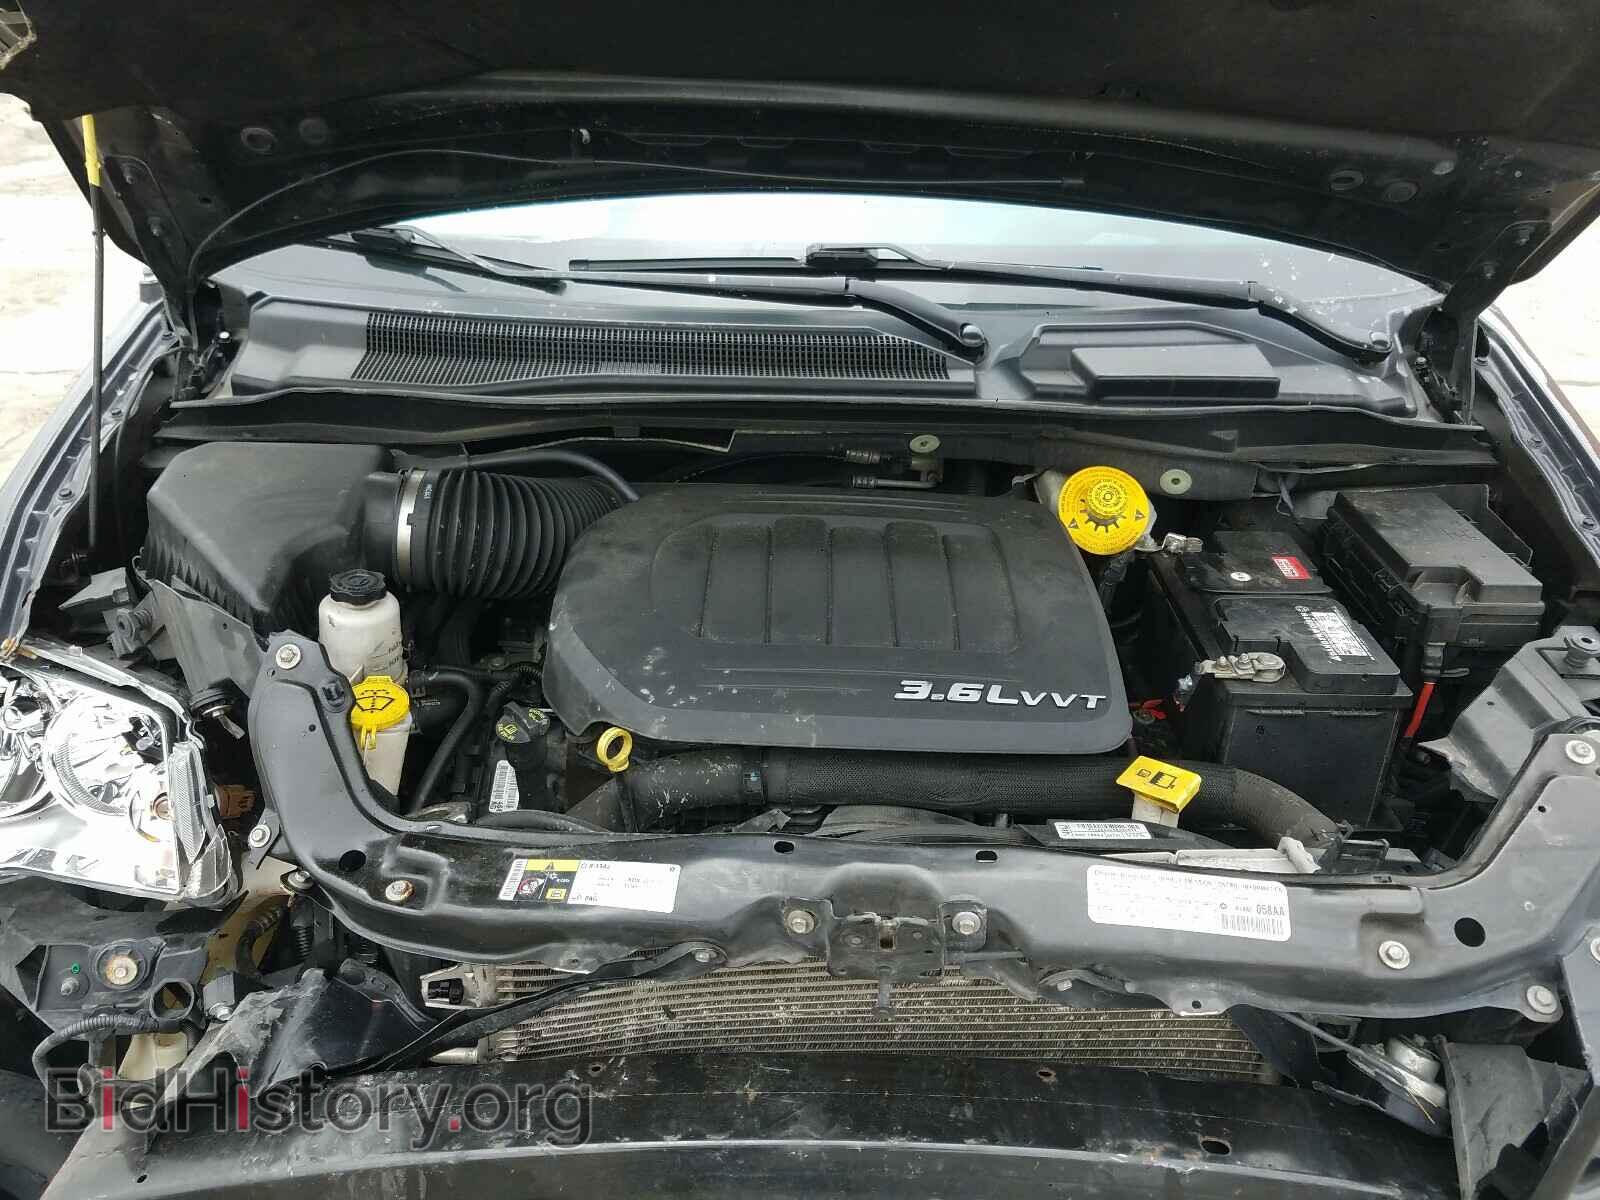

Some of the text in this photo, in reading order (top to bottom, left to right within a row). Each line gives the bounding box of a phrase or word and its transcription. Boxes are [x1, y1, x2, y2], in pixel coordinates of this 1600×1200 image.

[893, 679, 1106, 709] 3.6L VVT
[1255, 903, 1287, 917] 058AA
